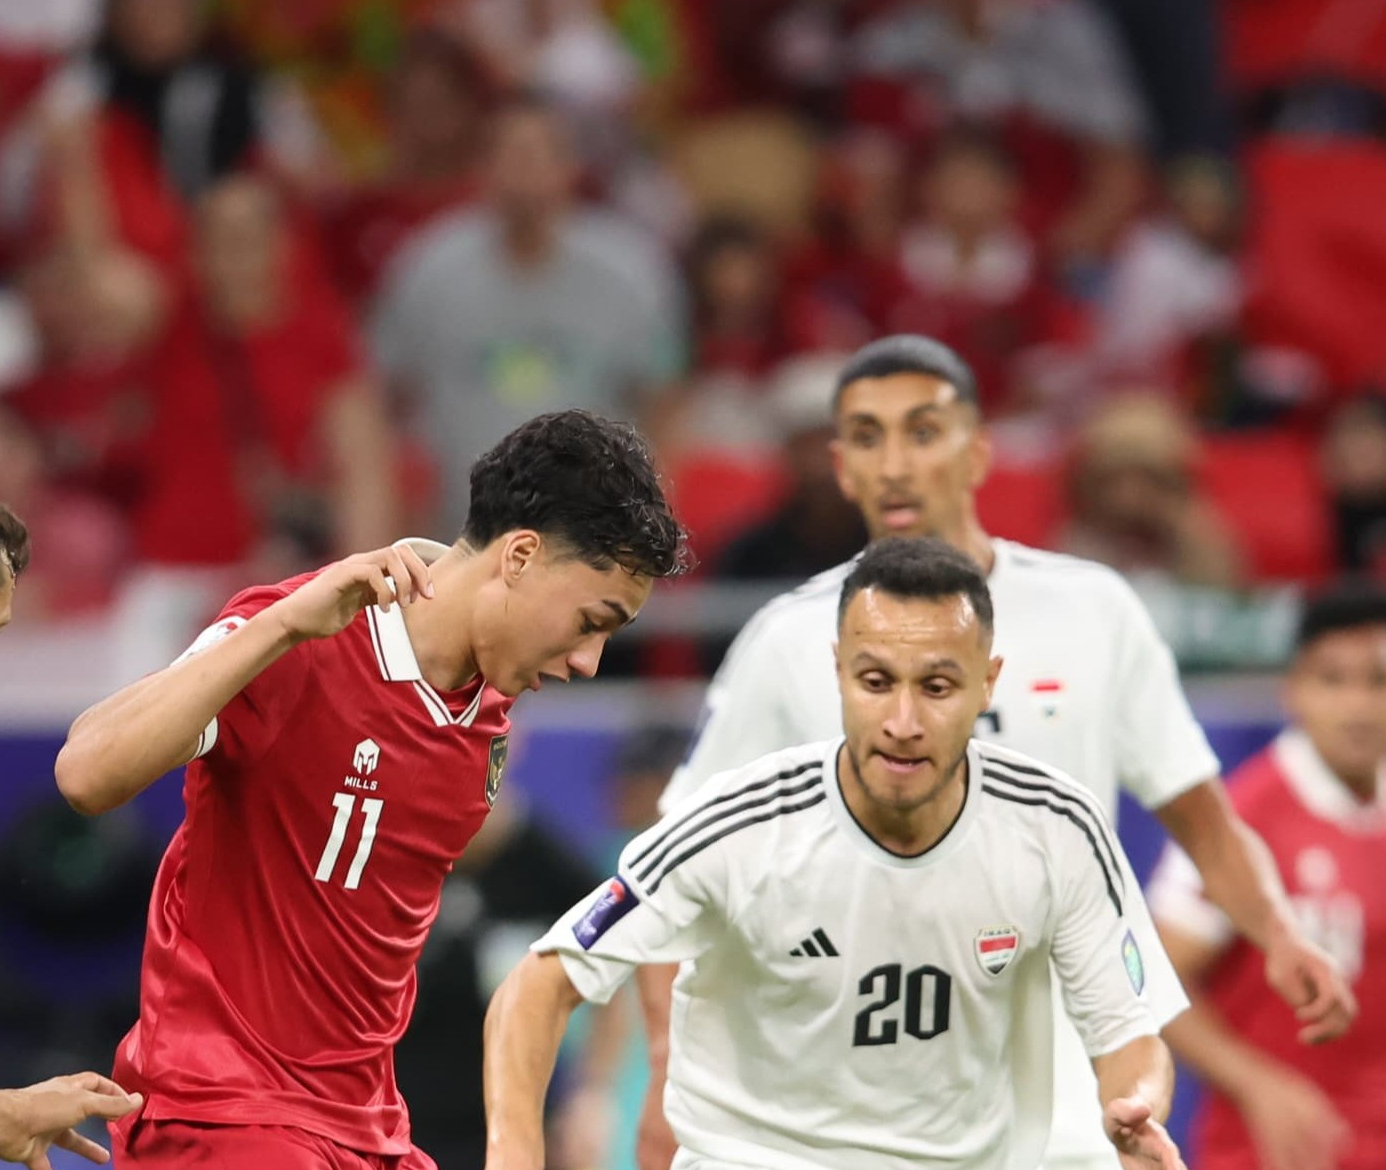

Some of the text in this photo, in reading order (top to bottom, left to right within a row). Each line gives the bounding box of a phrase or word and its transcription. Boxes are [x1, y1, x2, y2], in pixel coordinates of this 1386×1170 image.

[344, 775, 379, 792] MILLS
[314, 792, 384, 890] 11
[852, 962, 952, 1049] 20
